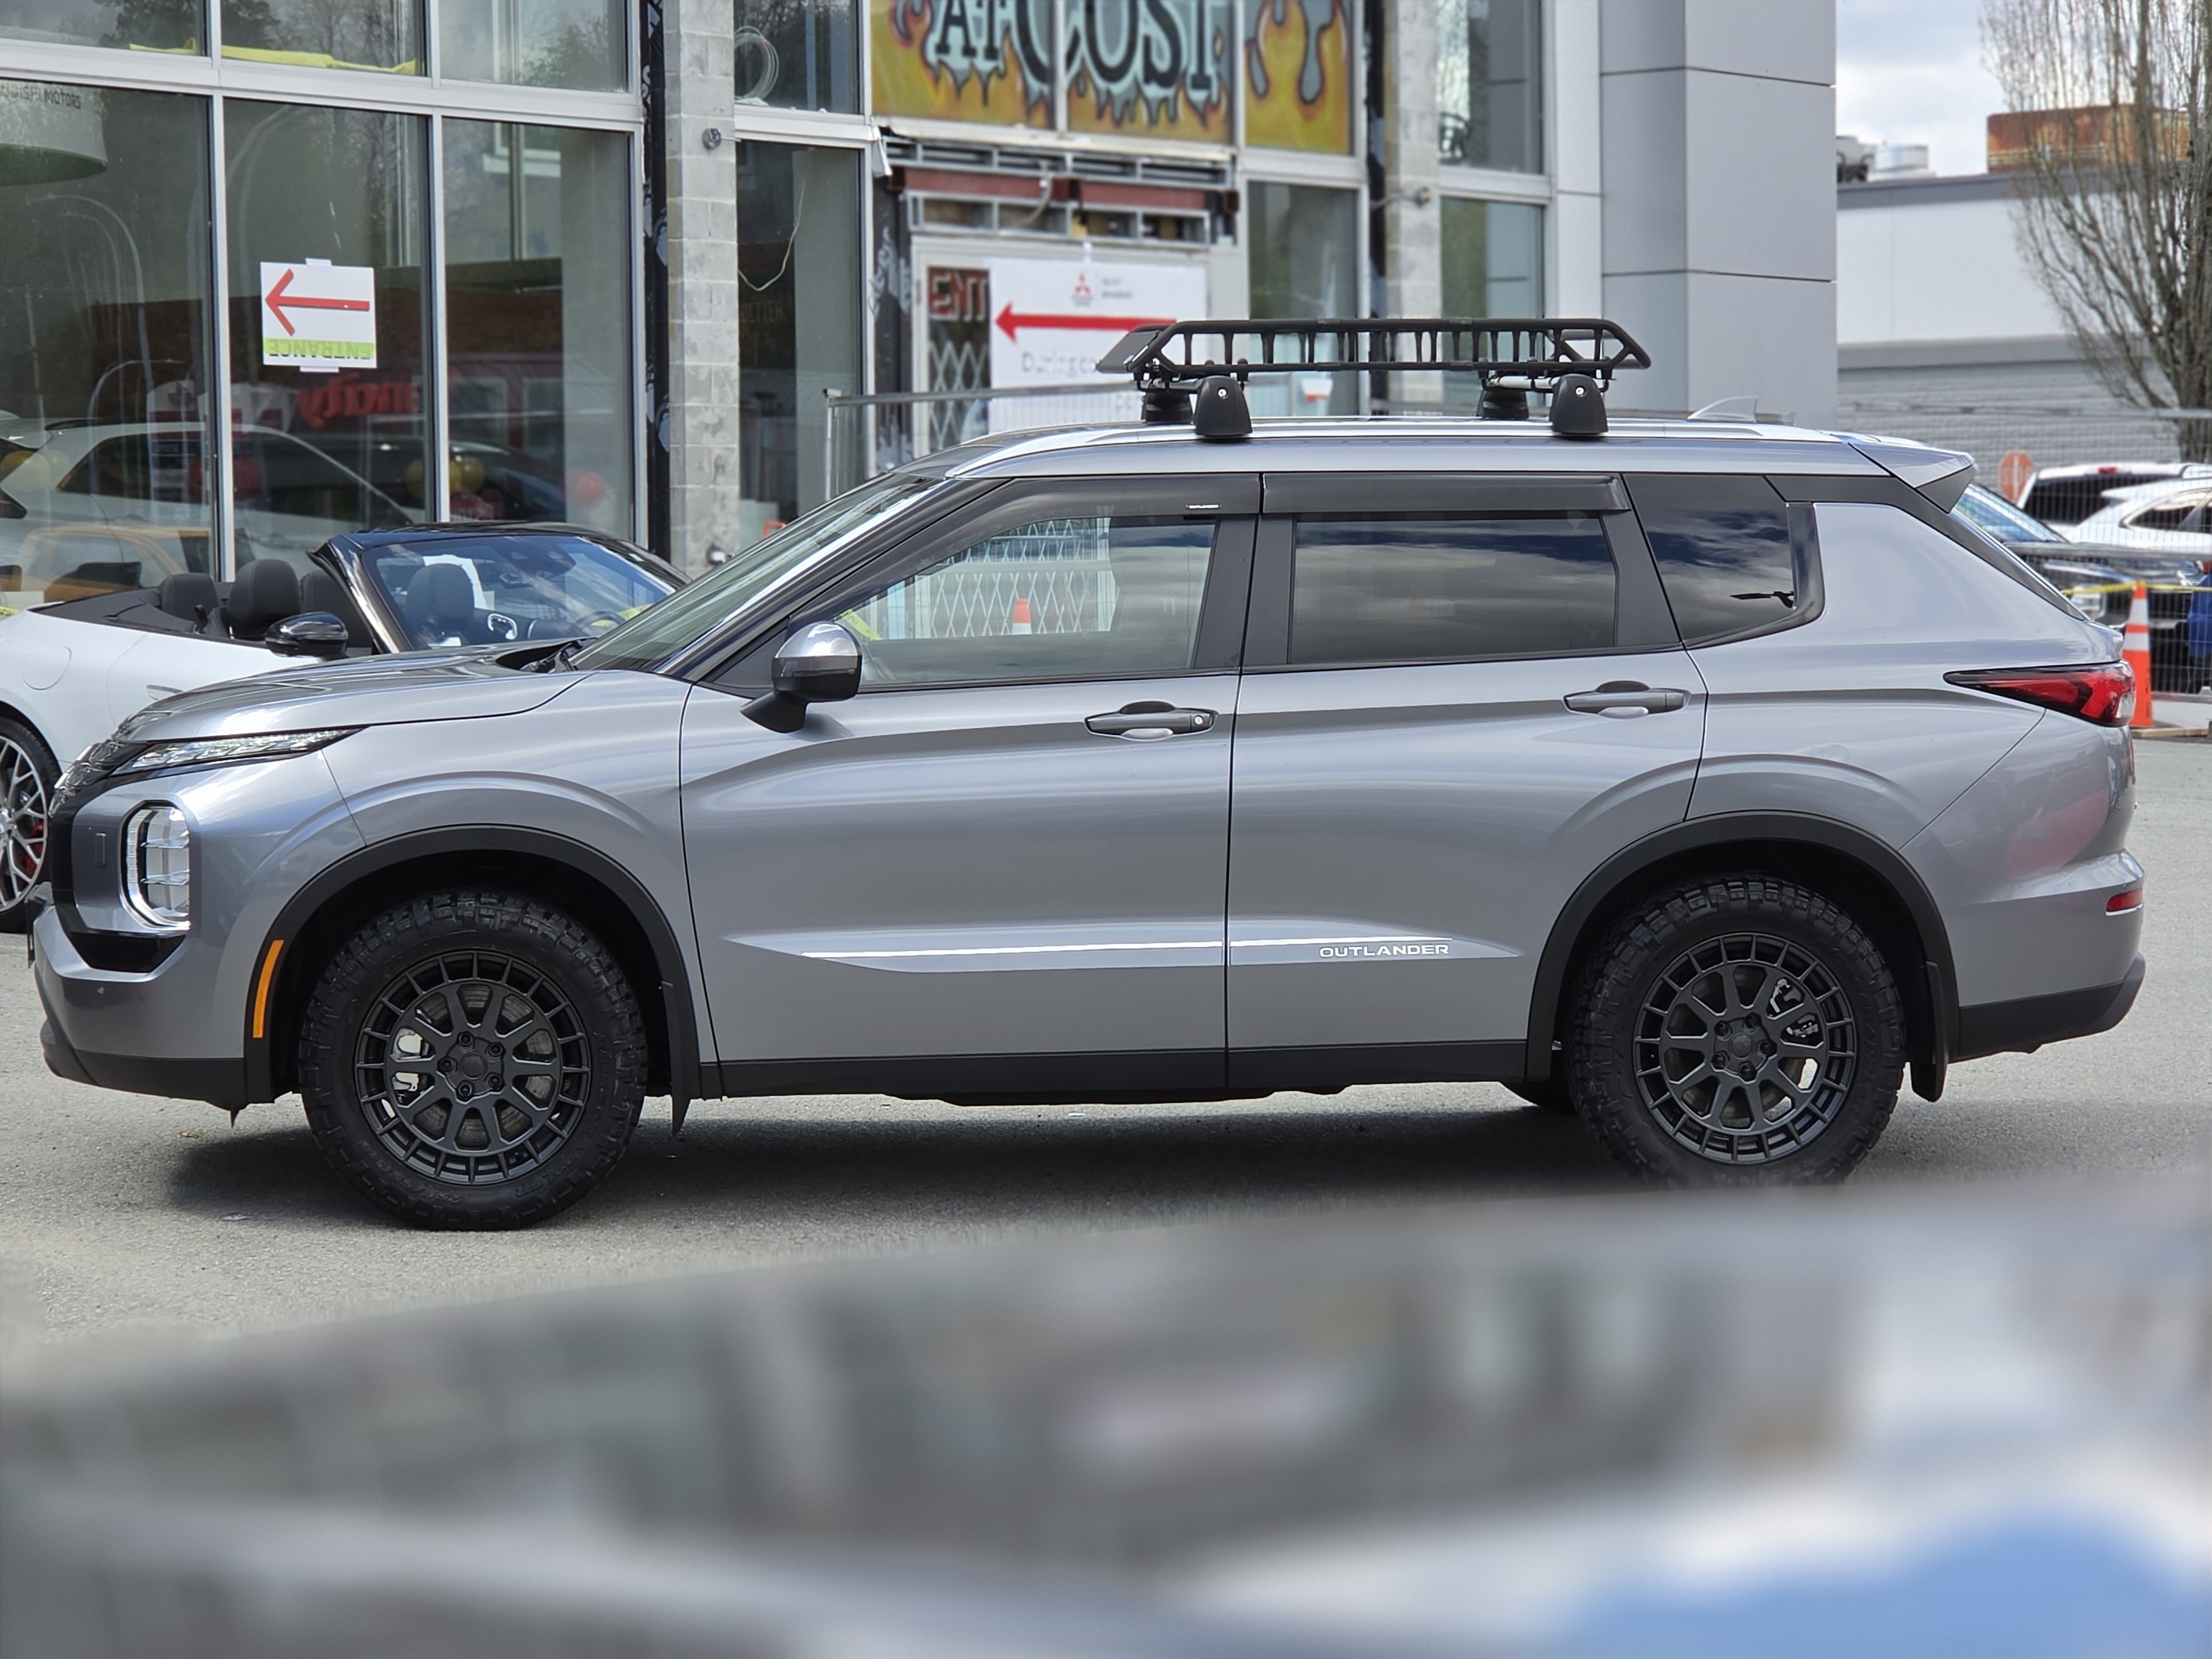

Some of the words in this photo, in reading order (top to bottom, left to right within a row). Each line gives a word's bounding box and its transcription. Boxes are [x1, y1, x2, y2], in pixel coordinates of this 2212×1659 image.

[44, 88, 81, 109] MOTORS
[269, 339, 372, 359] ENTRANCE
[1319, 944, 1449, 958] OUTLANDER
